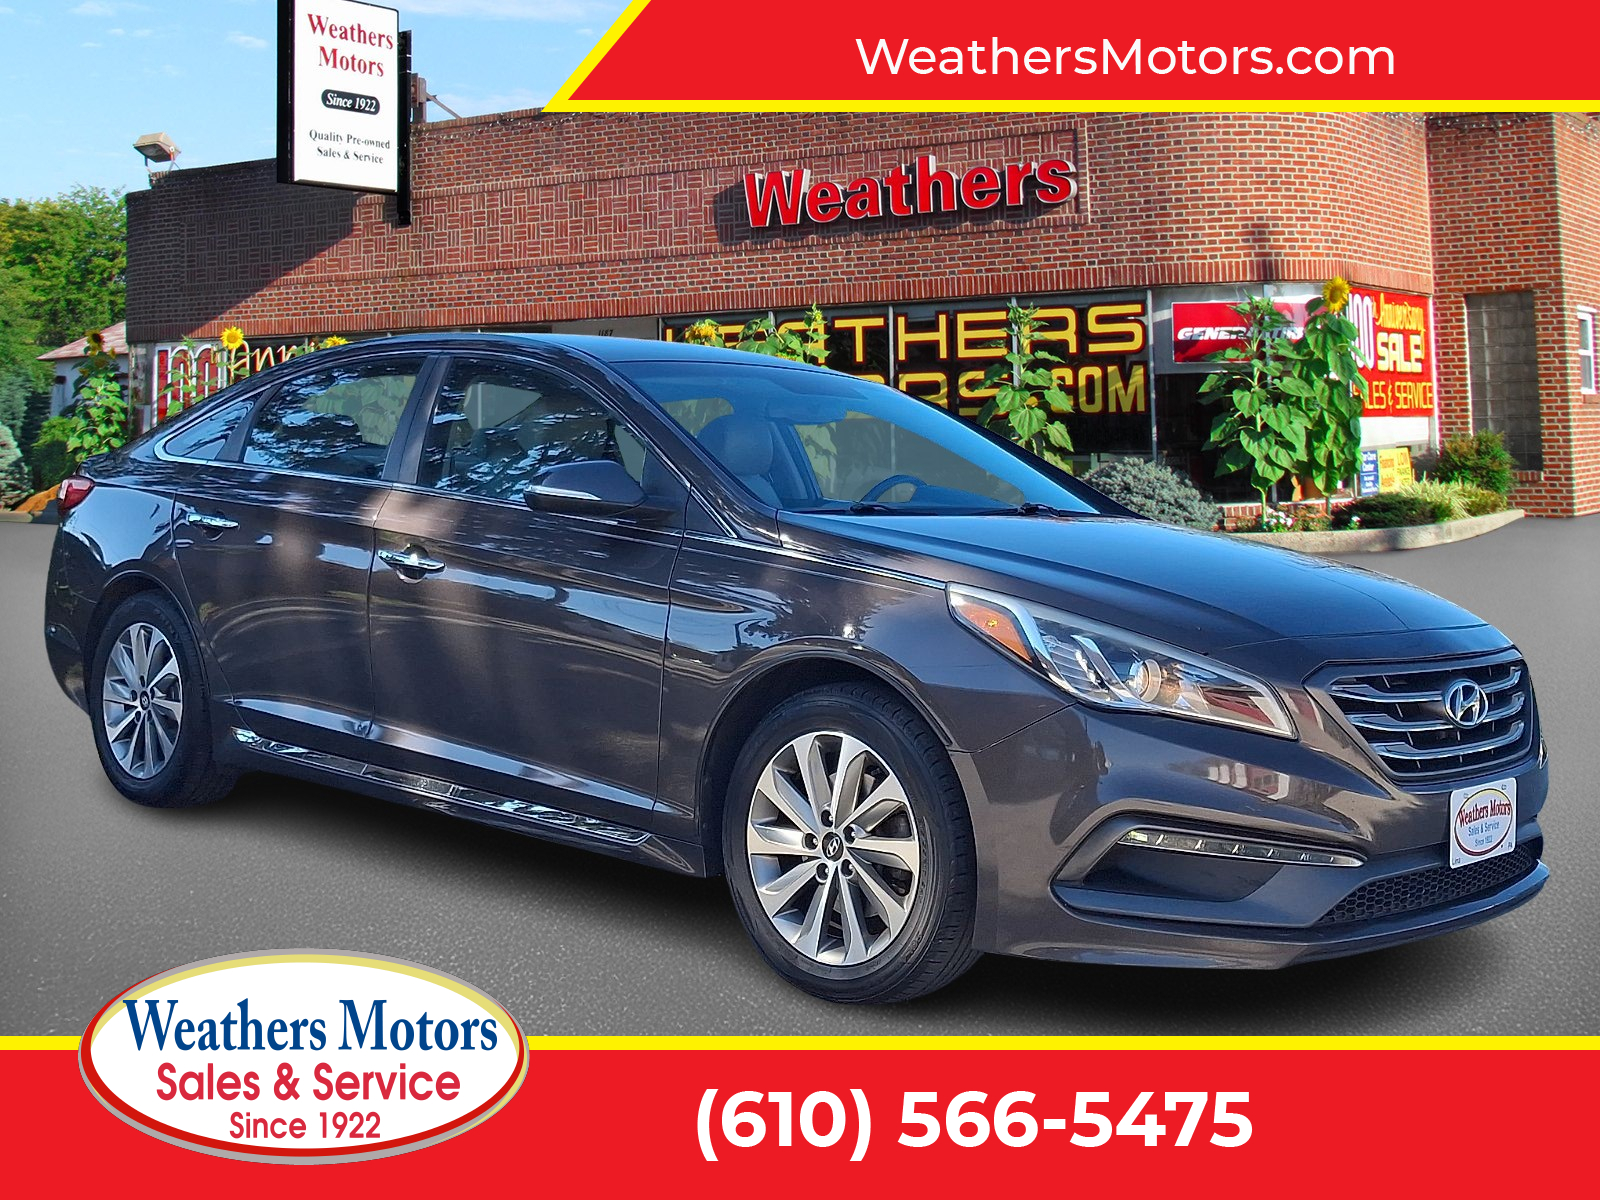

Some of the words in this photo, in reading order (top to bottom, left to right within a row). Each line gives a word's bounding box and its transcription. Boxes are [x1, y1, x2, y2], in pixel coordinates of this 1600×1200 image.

[307, 13, 394, 50] Weathers
[318, 45, 385, 78] Motors
[326, 92, 353, 108] Since
[355, 96, 376, 112] 1922
[309, 129, 343, 145] Quality
[346, 134, 391, 150] Pre-owned
[316, 146, 341, 159] Sales
[343, 152, 350, 160] &
[353, 152, 384, 164] Service
[743, 154, 1078, 229] Weathers
[1376, 331, 1422, 373] SALE
[1394, 381, 1434, 410] SERVICE
[1458, 803, 1489, 828] Weathers
[1490, 798, 1511, 818] Motors
[1468, 825, 1480, 837] Sales
[1484, 821, 1500, 833] Service
